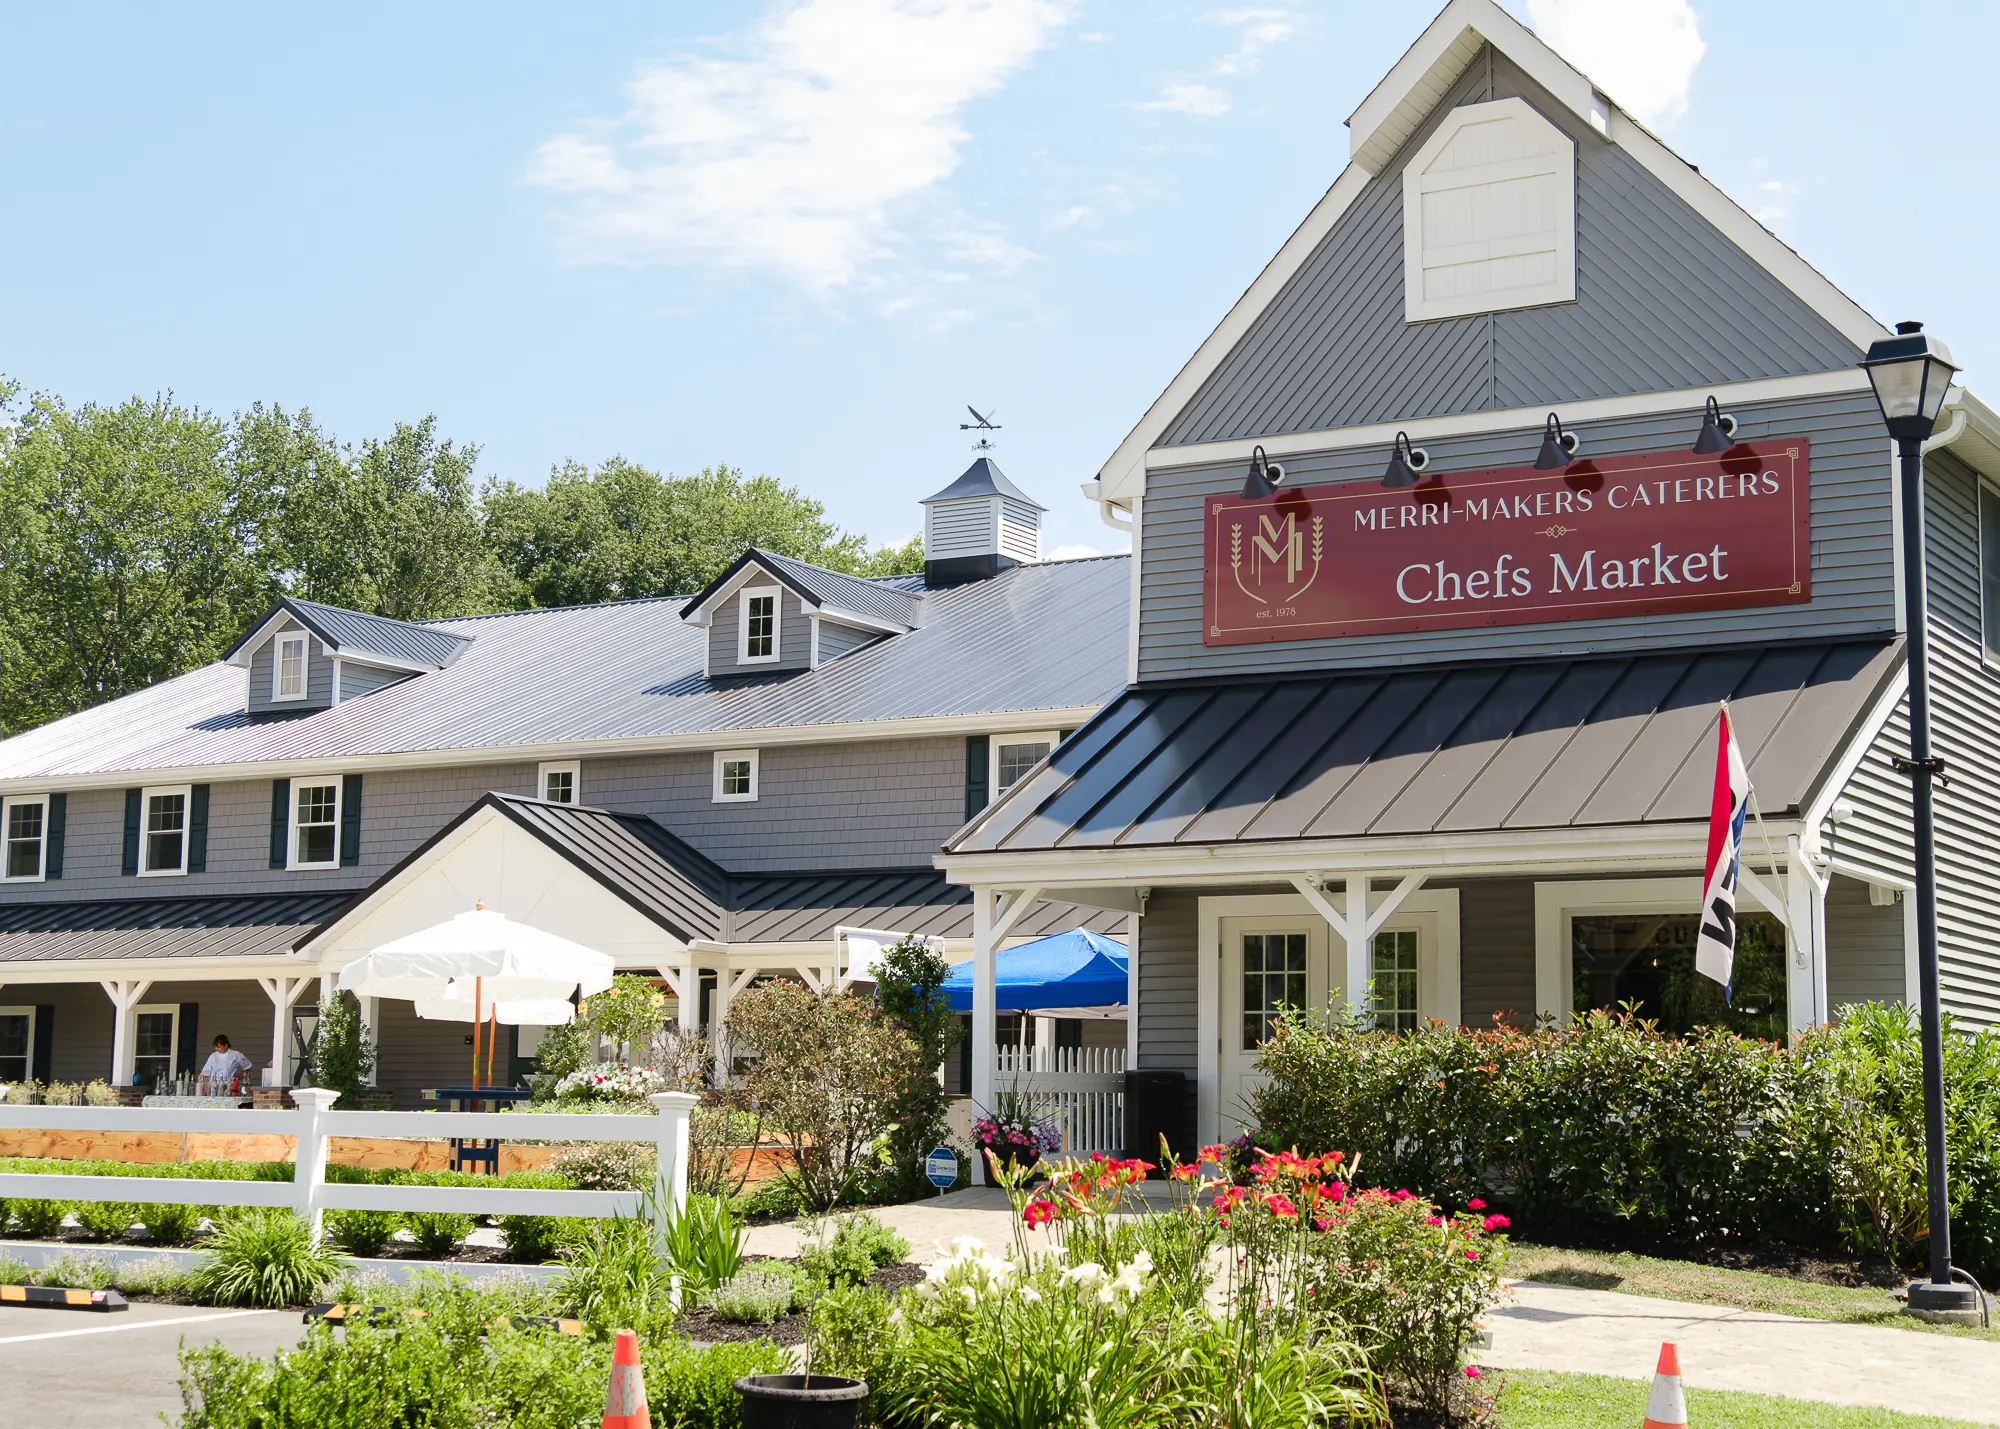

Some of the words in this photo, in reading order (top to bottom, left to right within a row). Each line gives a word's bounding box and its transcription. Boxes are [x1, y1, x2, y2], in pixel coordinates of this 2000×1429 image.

[1354, 488, 1593, 532] MERRI-MAKERS
[1607, 470, 1780, 509] CATERERS
[1396, 553, 1532, 604] Chefs
[1548, 542, 1729, 594] Market
[1256, 609, 1273, 619] est.
[1276, 606, 1297, 617] 1978
